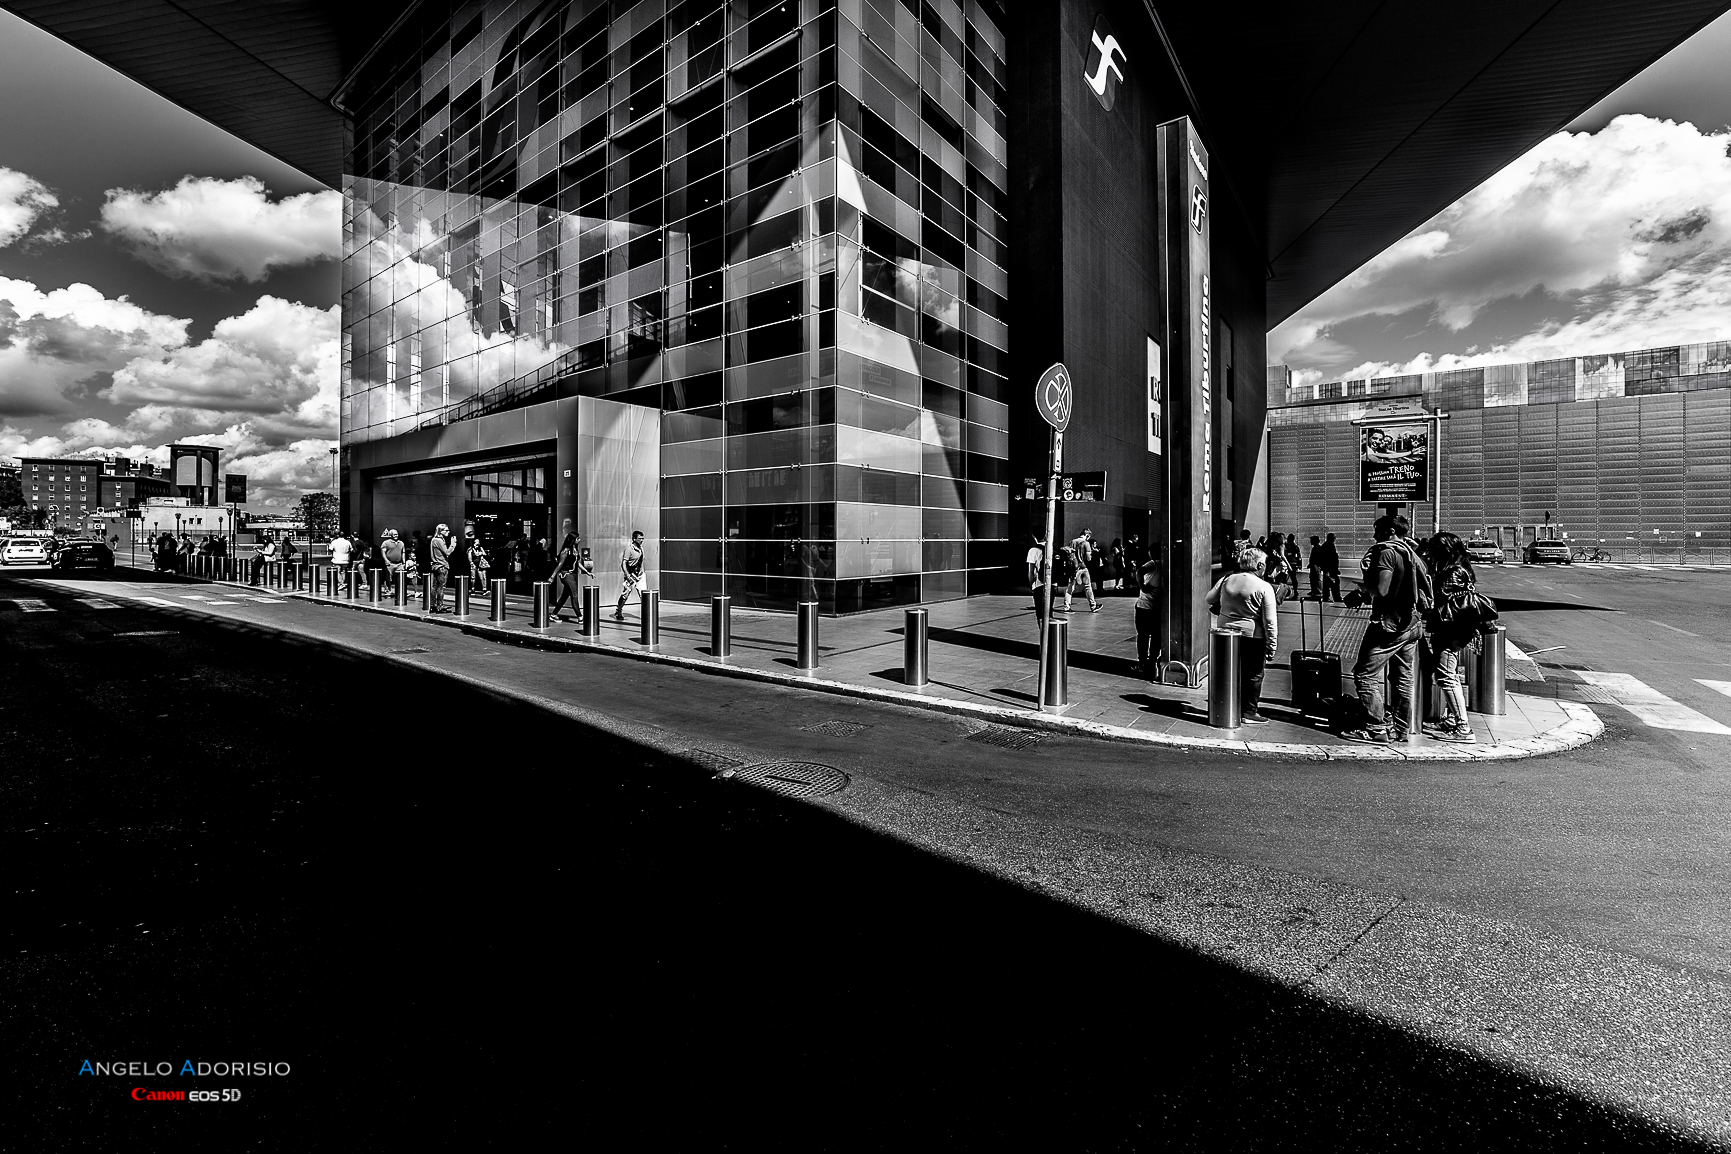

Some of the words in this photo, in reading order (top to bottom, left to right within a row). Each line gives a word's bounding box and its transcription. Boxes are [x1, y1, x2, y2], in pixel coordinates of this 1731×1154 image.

[1200, 274, 1211, 415] Tiburtina
[1202, 422, 1211, 513] Roma
[1388, 464, 1415, 474] TRENO
[1397, 472, 1404, 480] IL
[1405, 471, 1422, 479] TUO.
